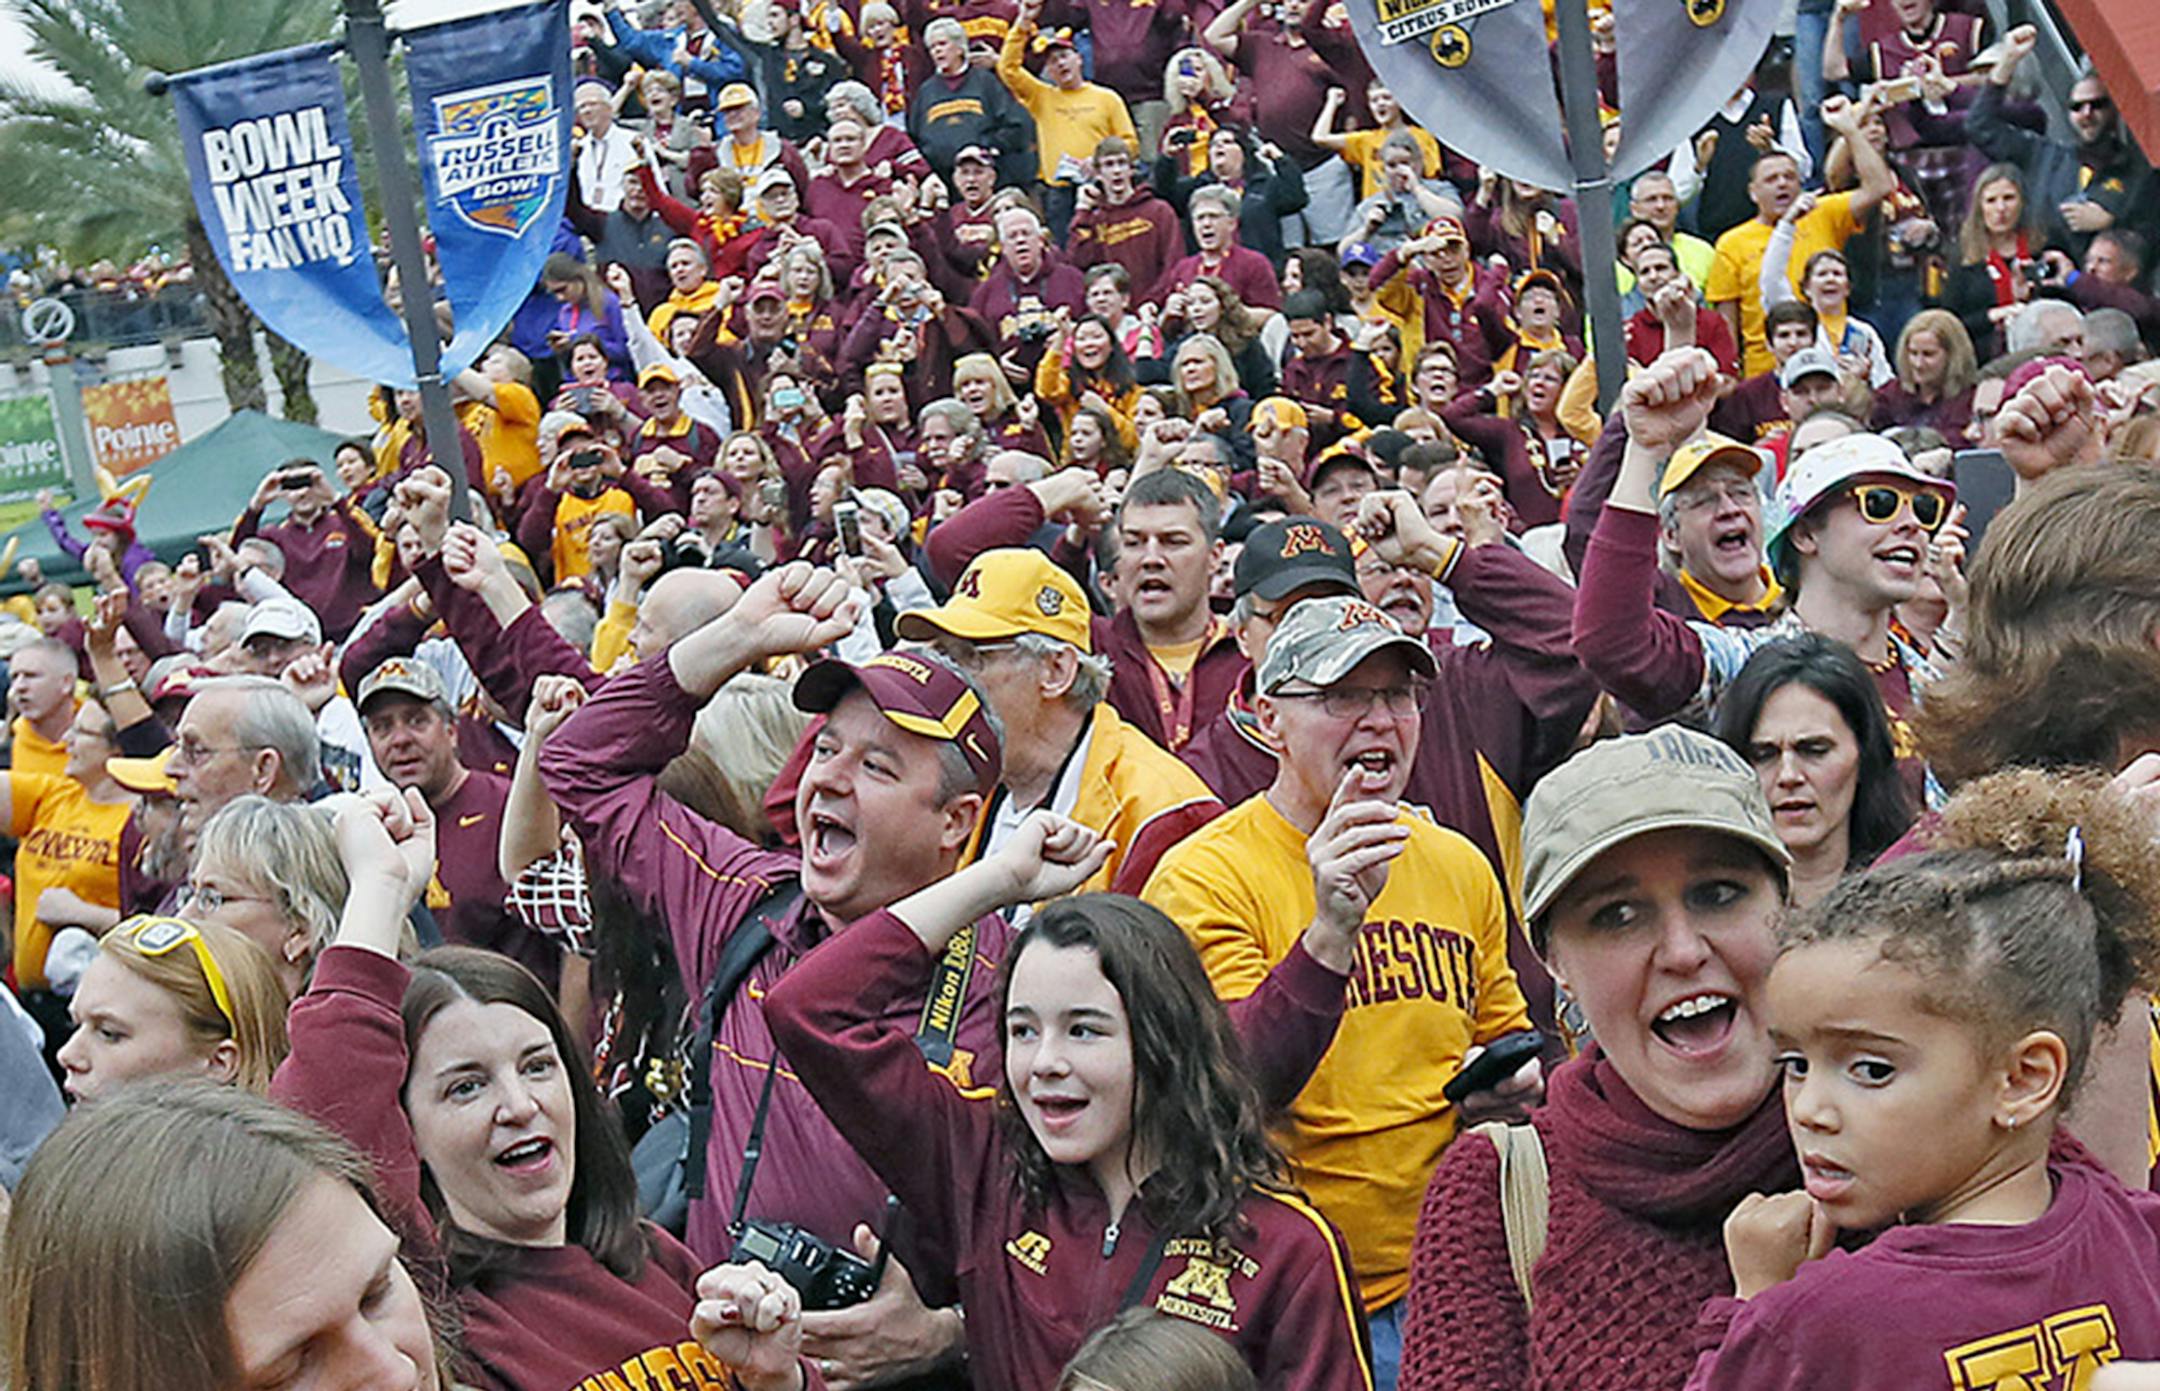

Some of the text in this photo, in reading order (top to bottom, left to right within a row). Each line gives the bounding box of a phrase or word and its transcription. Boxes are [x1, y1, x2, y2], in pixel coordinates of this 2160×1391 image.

[1386, 7, 1449, 40] CITRUS
[202, 106, 342, 184] BOWL
[440, 132, 553, 168] RUSSELL
[212, 160, 352, 233] WEEK
[472, 175, 540, 200] BOWL
[228, 212, 354, 272] FAN HQ
[95, 421, 175, 454] Pointe
[1280, 524, 1337, 558] M
[929, 970, 961, 1031] Nikon
[1155, 1293, 1231, 1329] MINNESOTA
